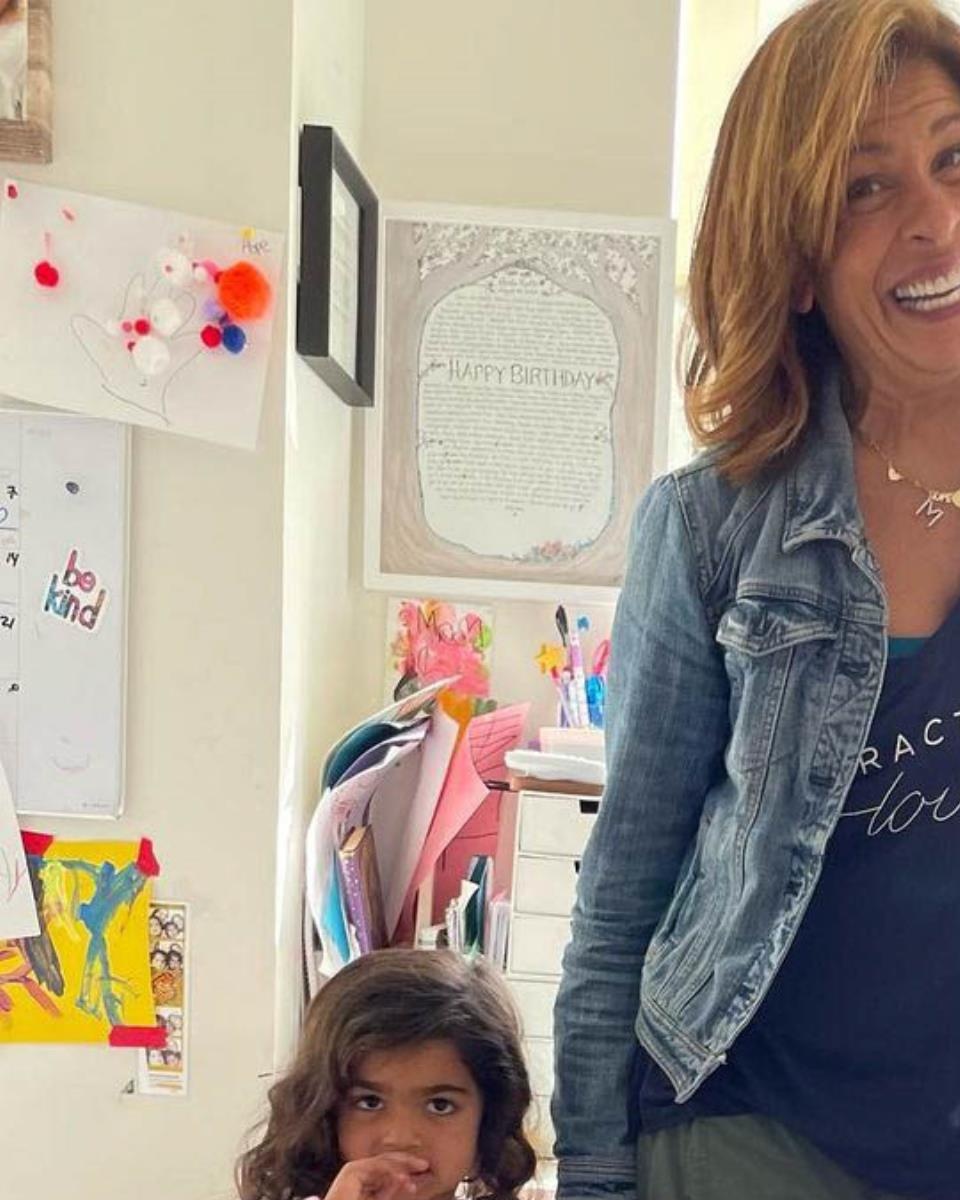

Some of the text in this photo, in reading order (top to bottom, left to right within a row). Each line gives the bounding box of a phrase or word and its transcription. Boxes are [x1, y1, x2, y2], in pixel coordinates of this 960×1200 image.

[449, 359, 595, 390] HAPPY BIRTHDAY
[62, 549, 96, 593] be
[44, 573, 106, 630] kind
